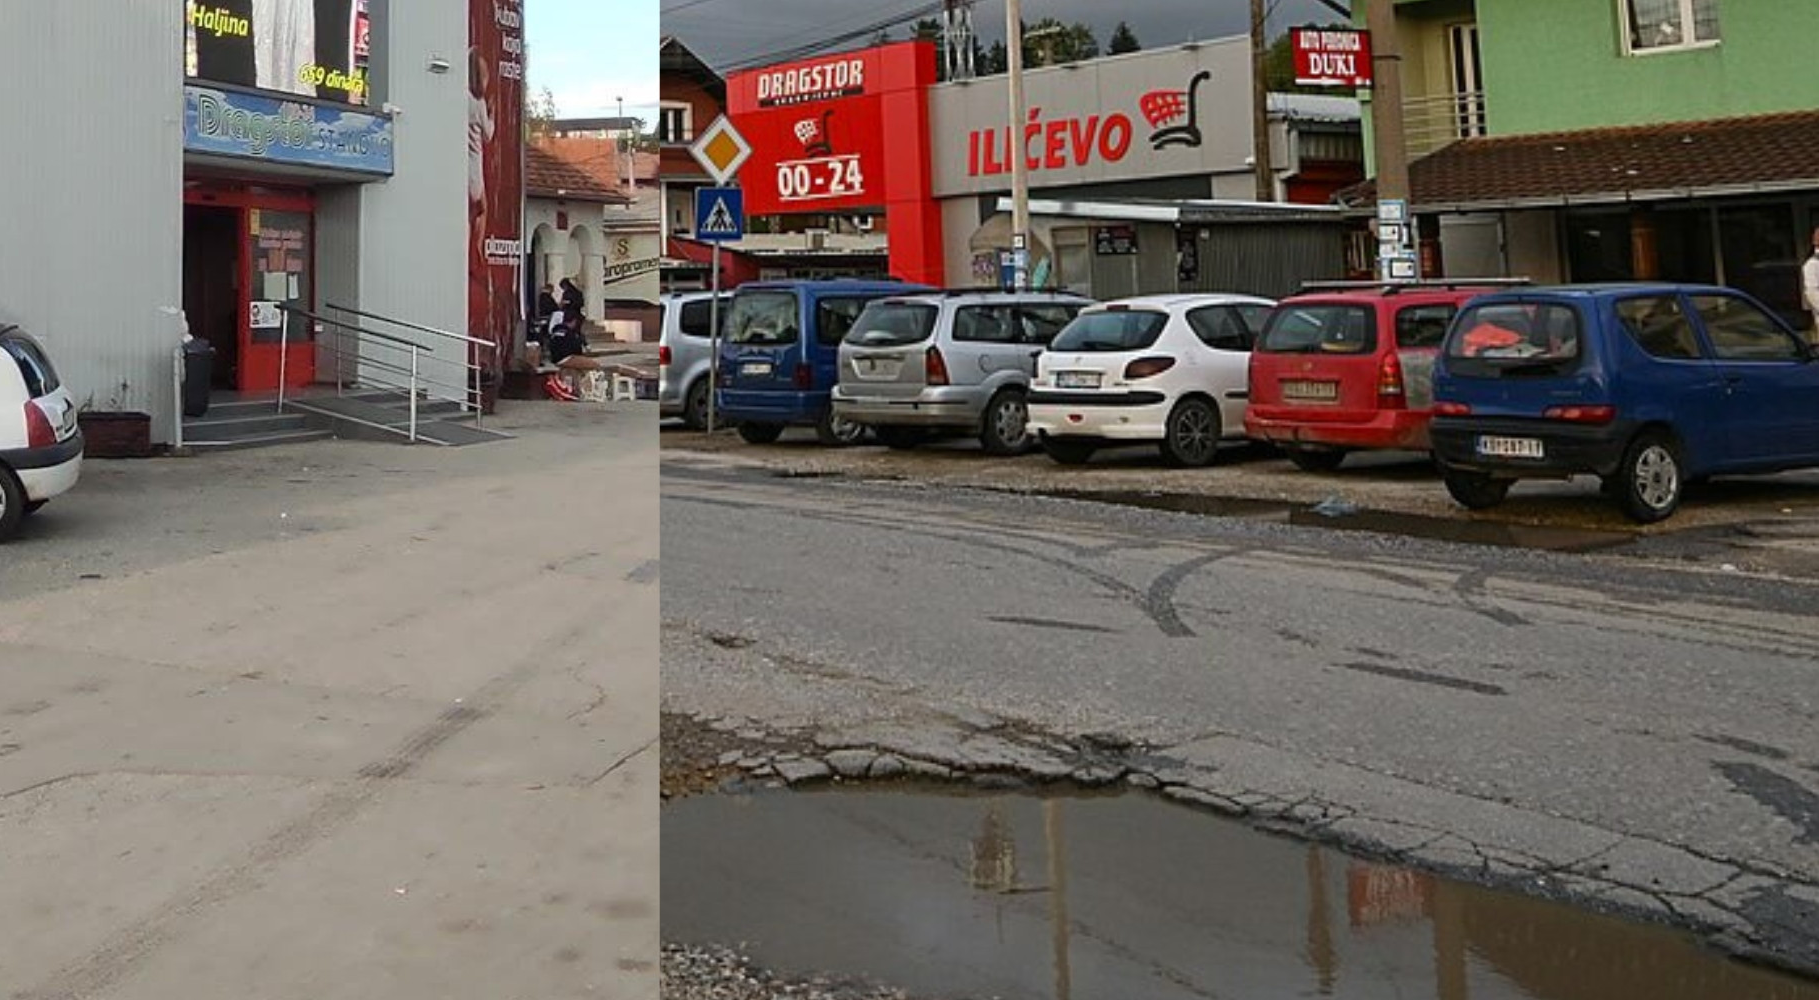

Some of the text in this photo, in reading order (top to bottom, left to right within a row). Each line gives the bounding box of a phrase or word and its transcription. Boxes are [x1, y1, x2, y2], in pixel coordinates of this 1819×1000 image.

[190, 3, 248, 37] Haljina
[299, 62, 365, 94] 659 dinara
[757, 59, 864, 99] DRAGSTOR
[1308, 52, 1356, 76] DUKI
[967, 107, 1134, 177] ILIĆEVO
